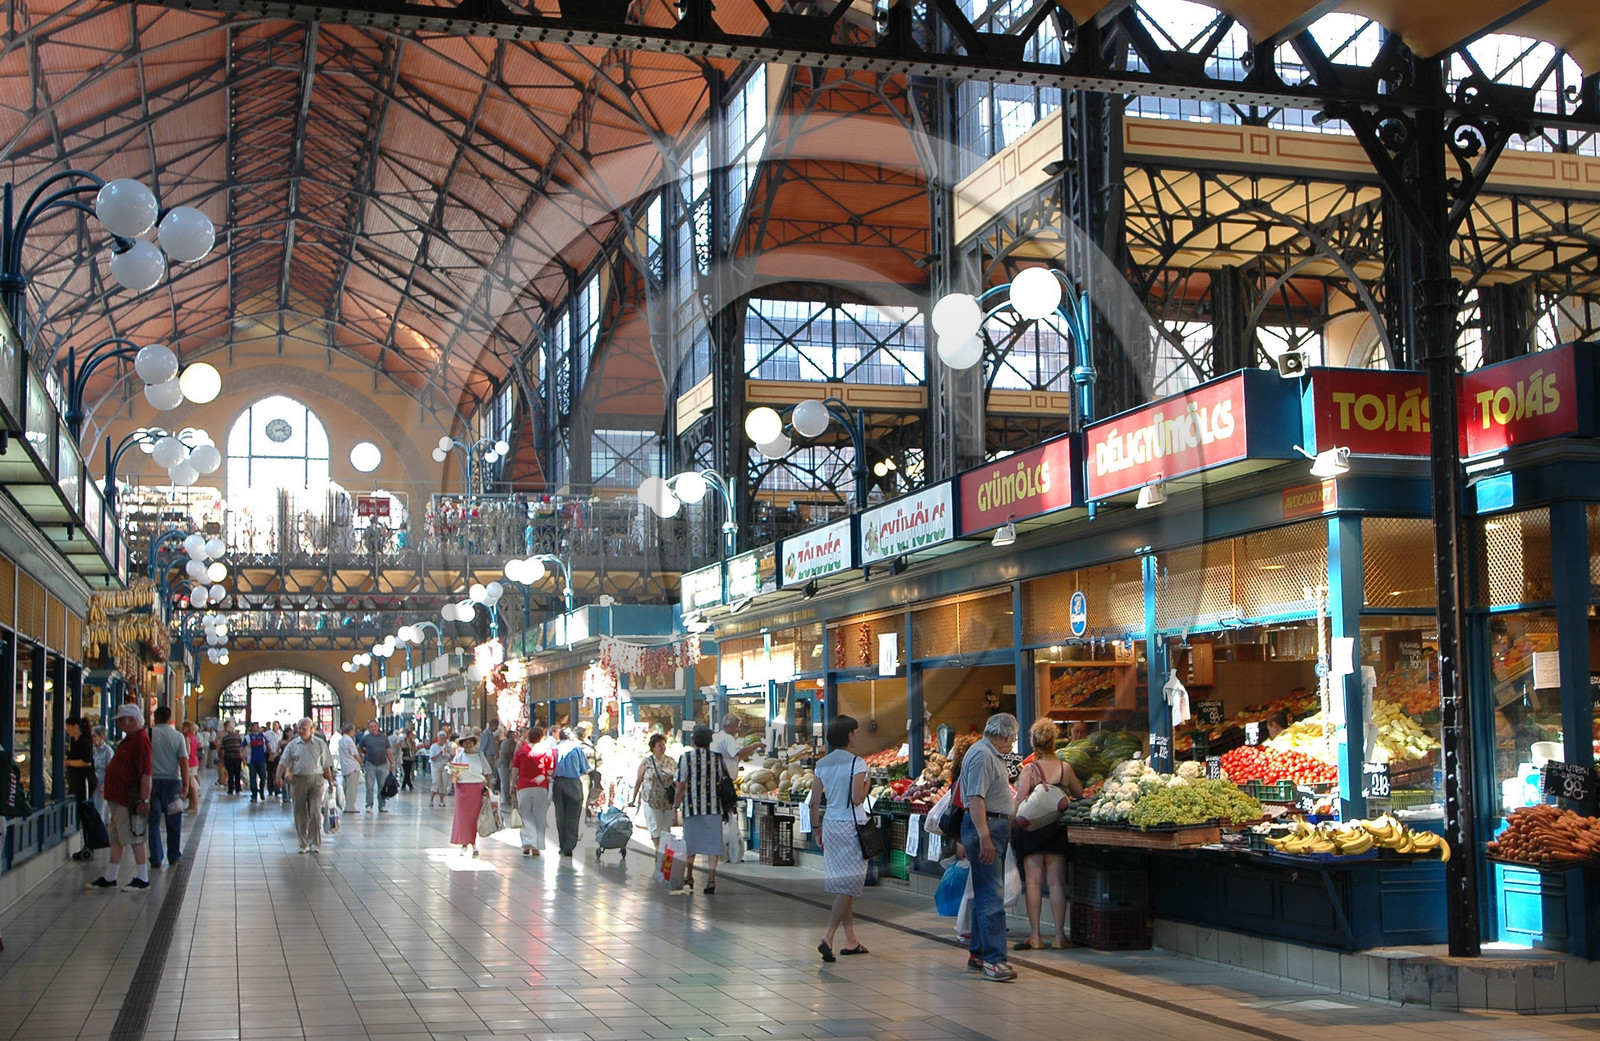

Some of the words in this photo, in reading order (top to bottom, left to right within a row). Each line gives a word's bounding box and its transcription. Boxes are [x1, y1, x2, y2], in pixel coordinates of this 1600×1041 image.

[1476, 368, 1561, 430] TOJÁS
[1096, 399, 1235, 478] DÉLIGYÜMÖLCS
[977, 461, 1051, 512] GYÜMÖLCS
[1285, 490, 1316, 509] AVOCADO
[1317, 486, 1333, 501] KFT
[880, 500, 946, 557] GYÜMÖLCS
[797, 532, 842, 580] ZÖLDSÉG
